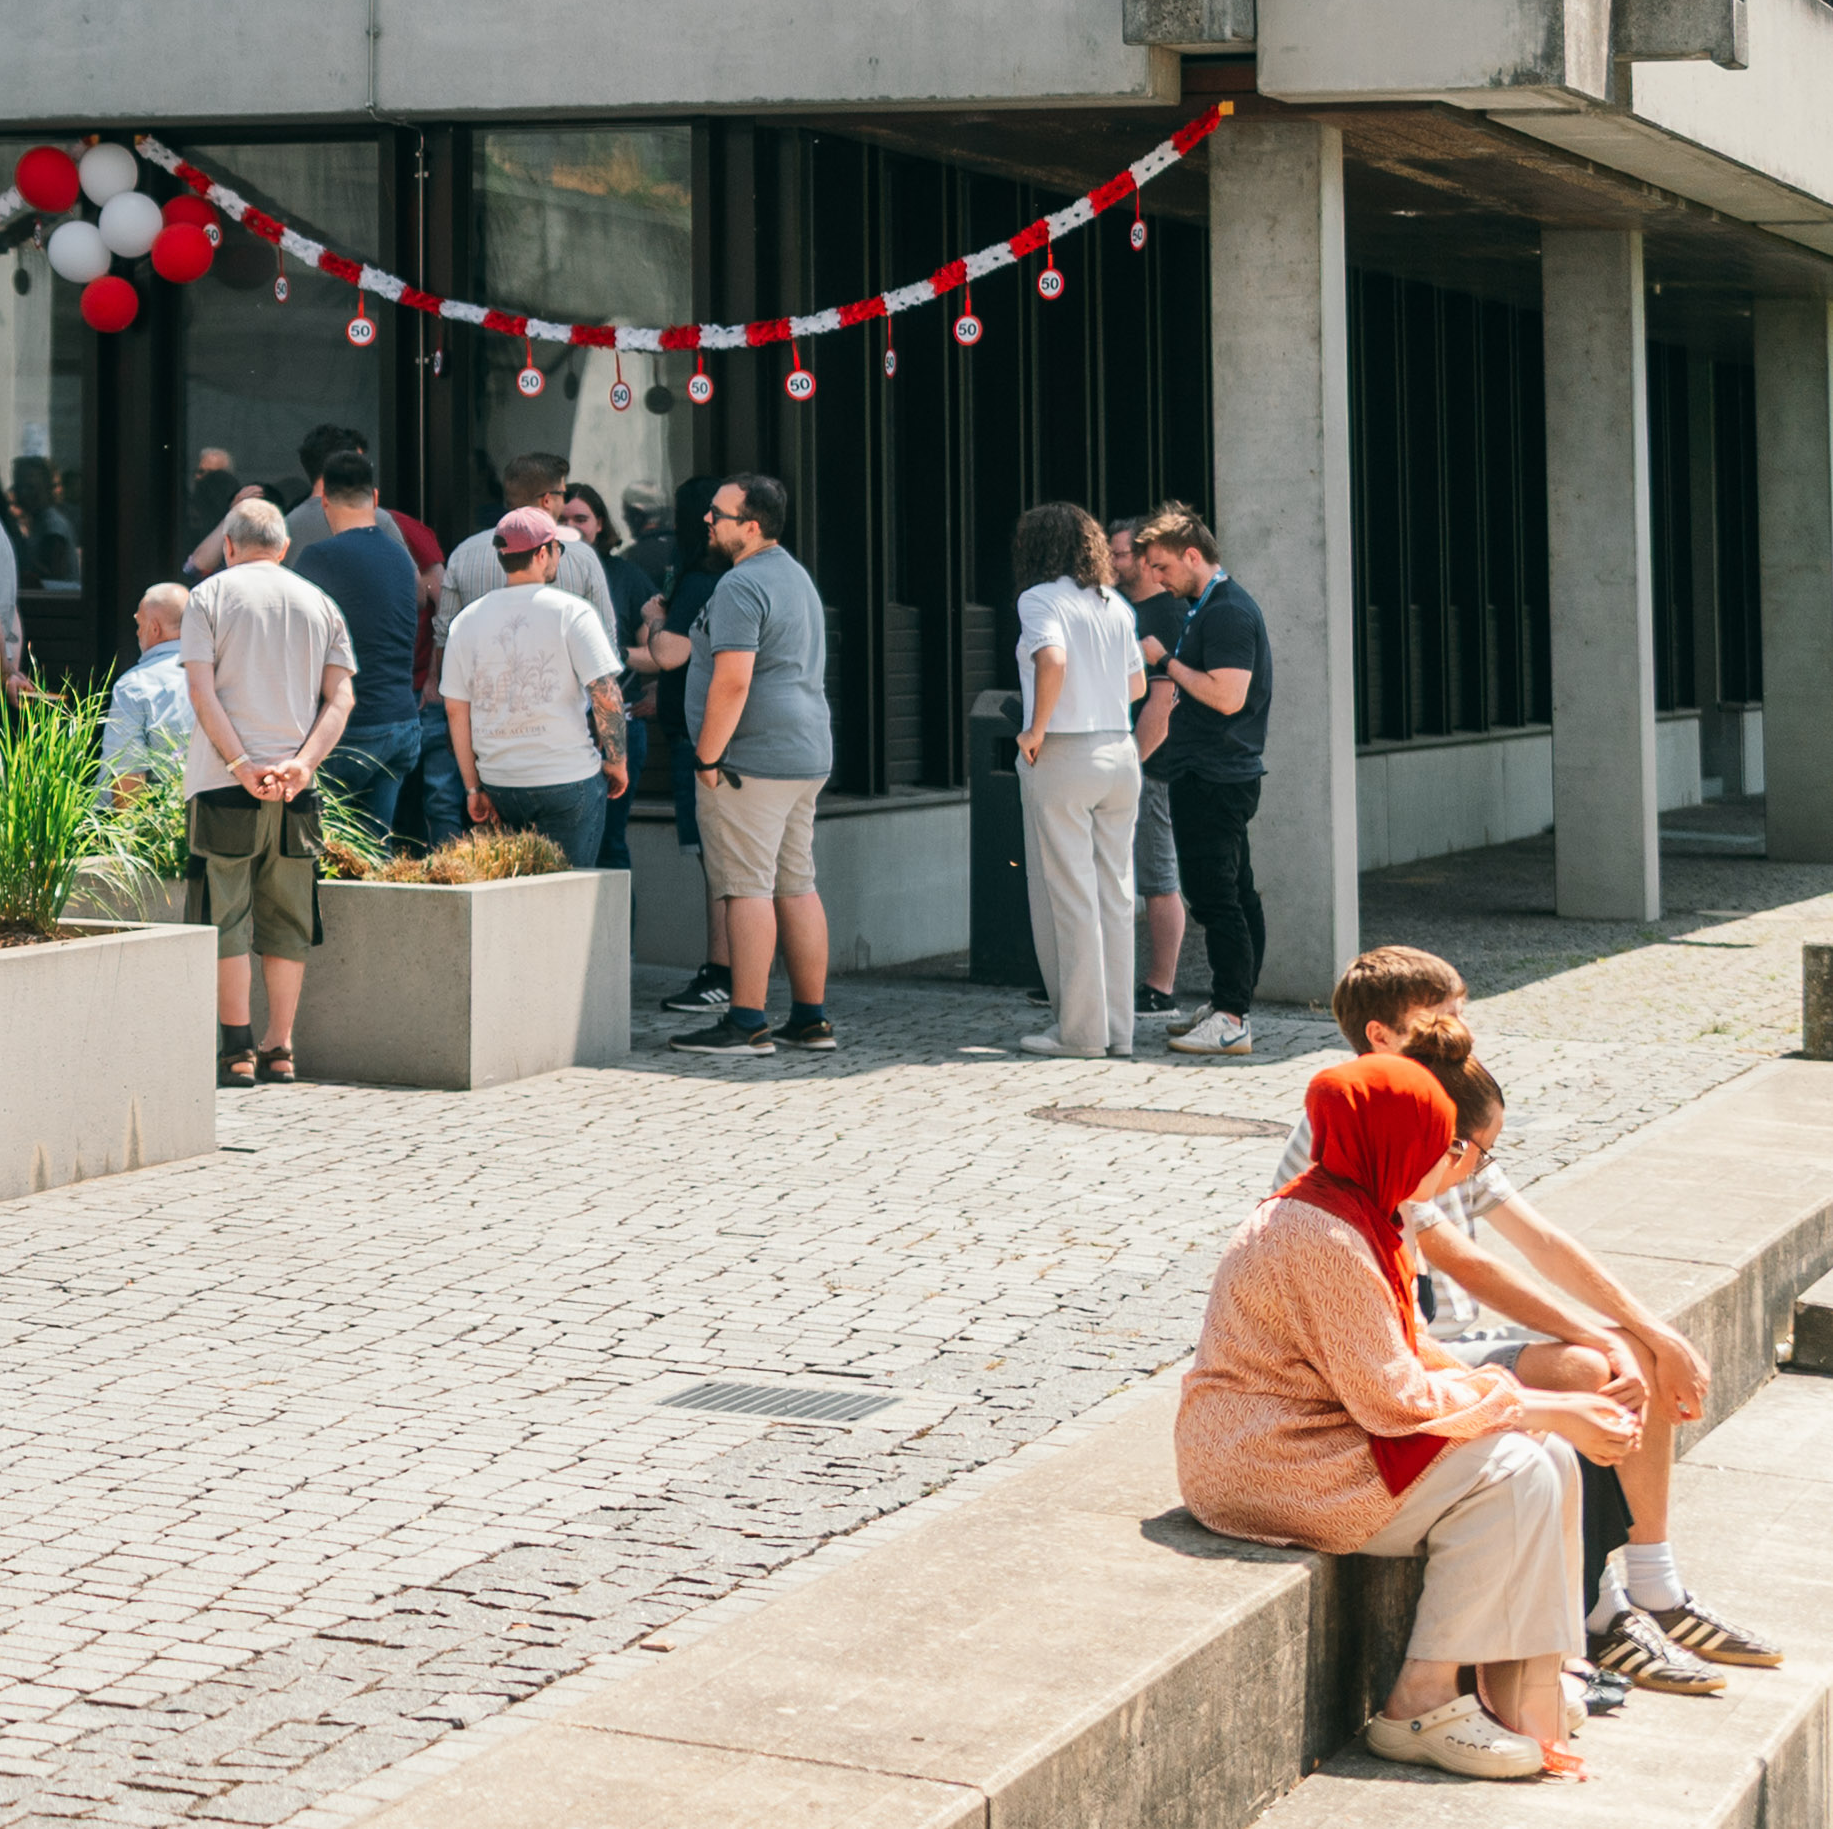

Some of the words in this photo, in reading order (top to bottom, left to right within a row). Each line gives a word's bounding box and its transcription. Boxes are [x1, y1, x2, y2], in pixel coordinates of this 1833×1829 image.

[1132, 227, 1143, 242] 50
[276, 282, 287, 295] 50
[1040, 276, 1060, 291] 50
[350, 324, 370, 338] 50
[957, 322, 978, 337] 50
[520, 375, 540, 389] 50
[691, 381, 709, 395] 50
[789, 377, 810, 392] 50
[613, 389, 628, 403] 50
